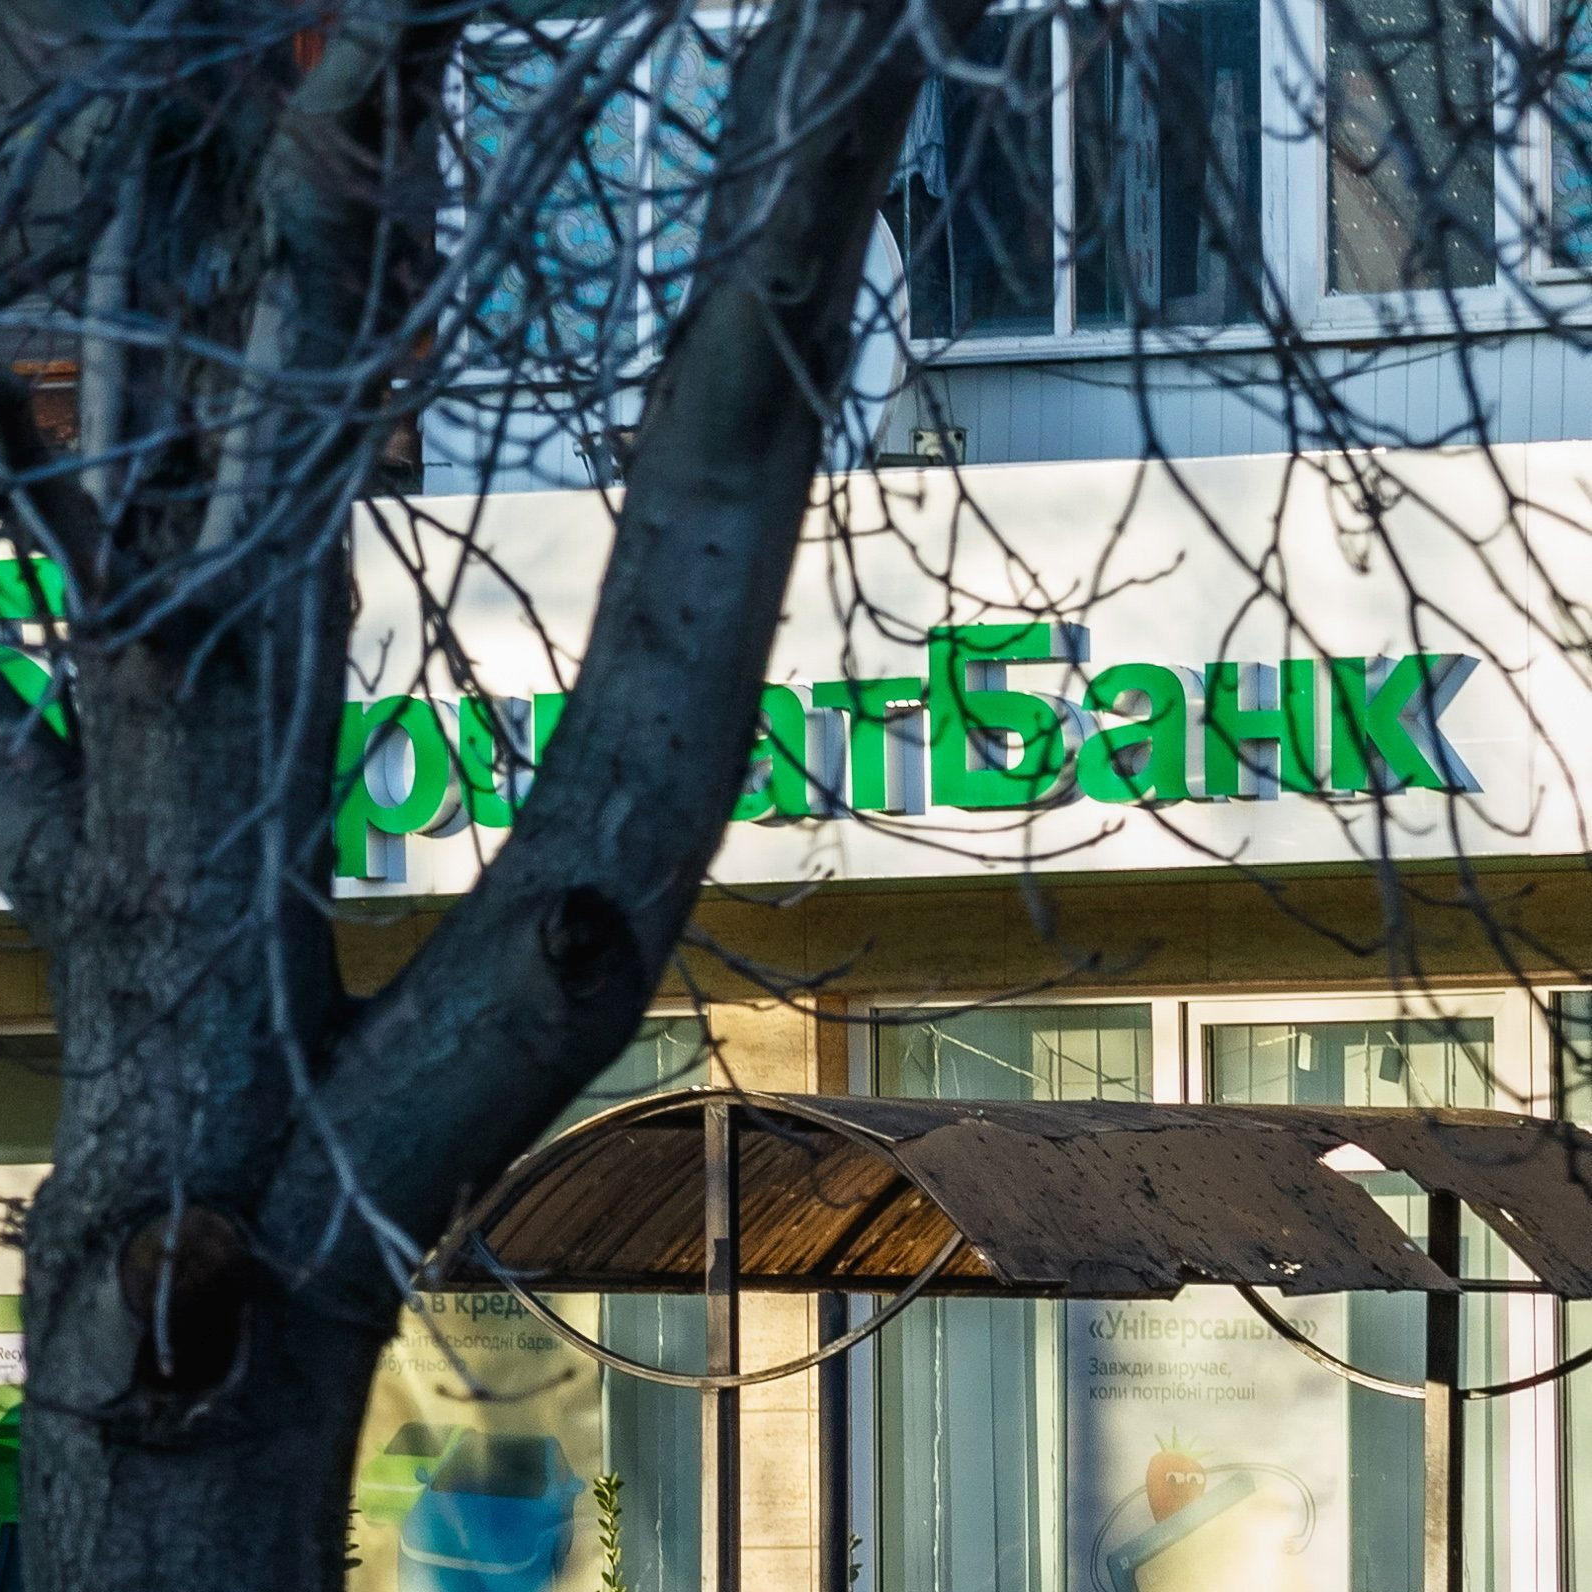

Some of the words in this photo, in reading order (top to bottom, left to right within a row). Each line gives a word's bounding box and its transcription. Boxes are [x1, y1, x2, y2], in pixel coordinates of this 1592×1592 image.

[1088, 1357, 1154, 1378] Завжди
[1158, 1361, 1232, 1378] виручає,
[1088, 1386, 1127, 1400] коли
[1132, 1383, 1202, 1404] потрібні
[1207, 1383, 1255, 1404] гроші
